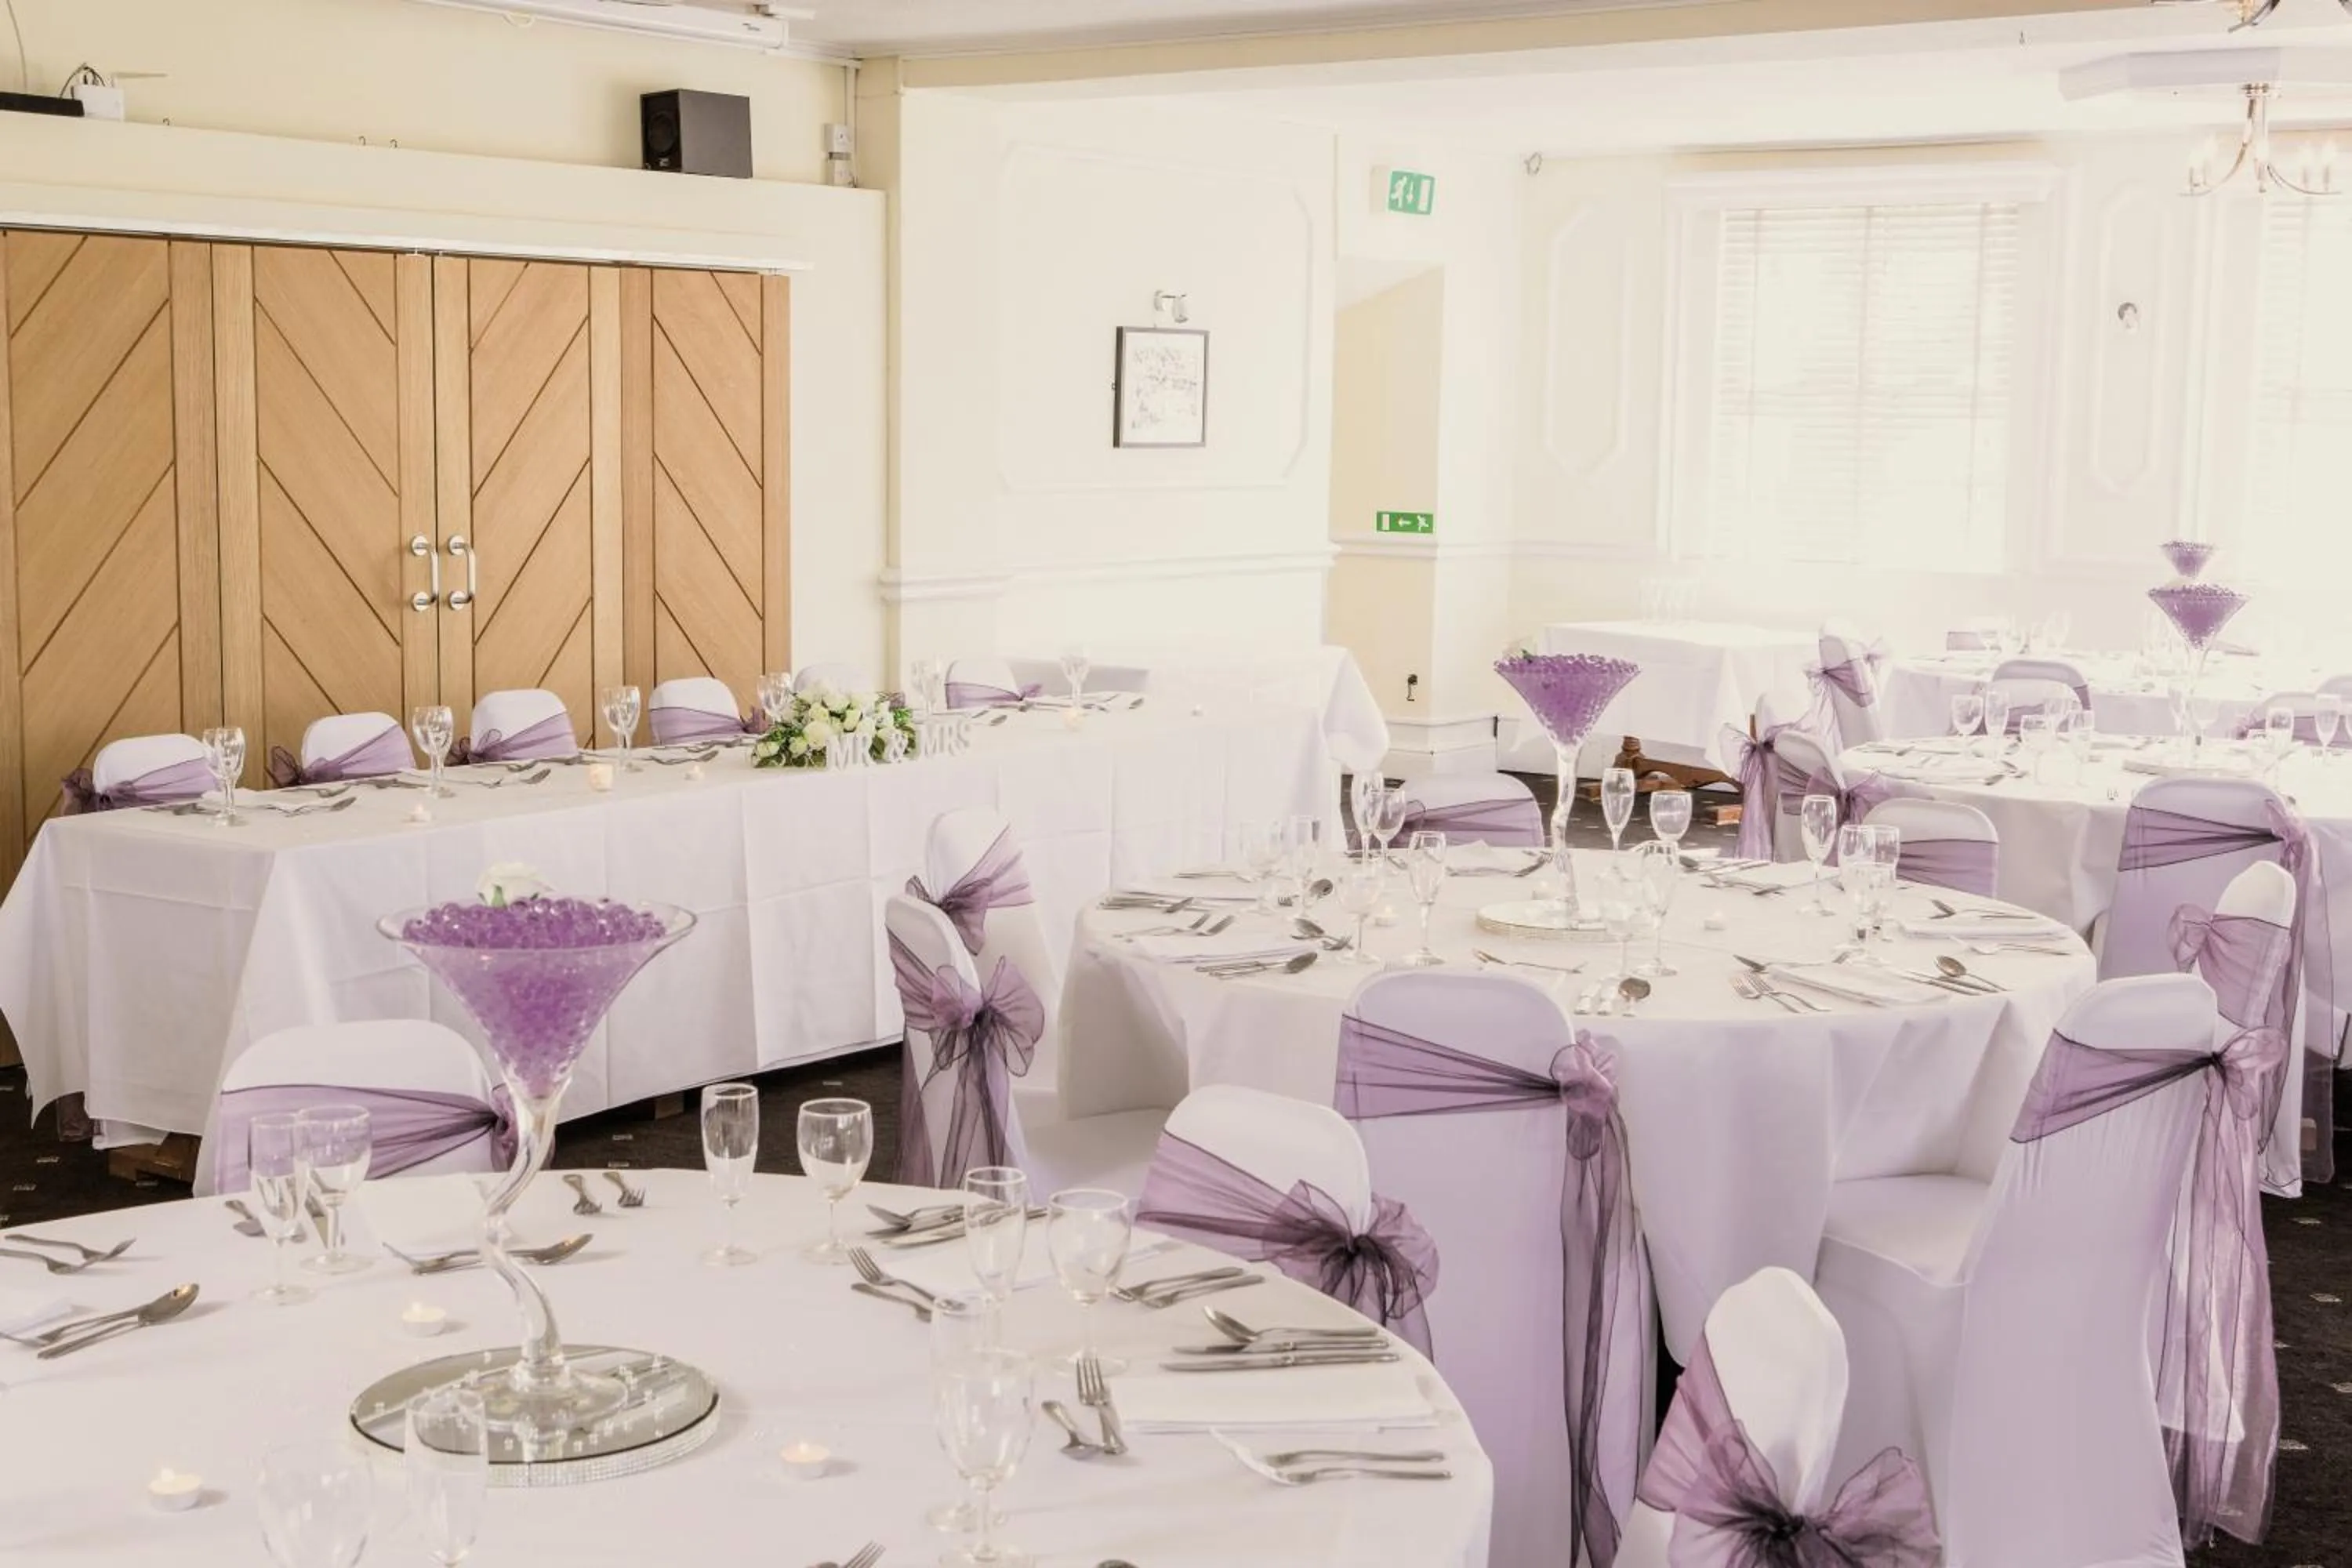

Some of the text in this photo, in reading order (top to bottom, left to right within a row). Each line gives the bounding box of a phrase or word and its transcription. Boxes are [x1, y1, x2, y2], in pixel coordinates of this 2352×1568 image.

[826, 718, 971, 771] MR & MRS
